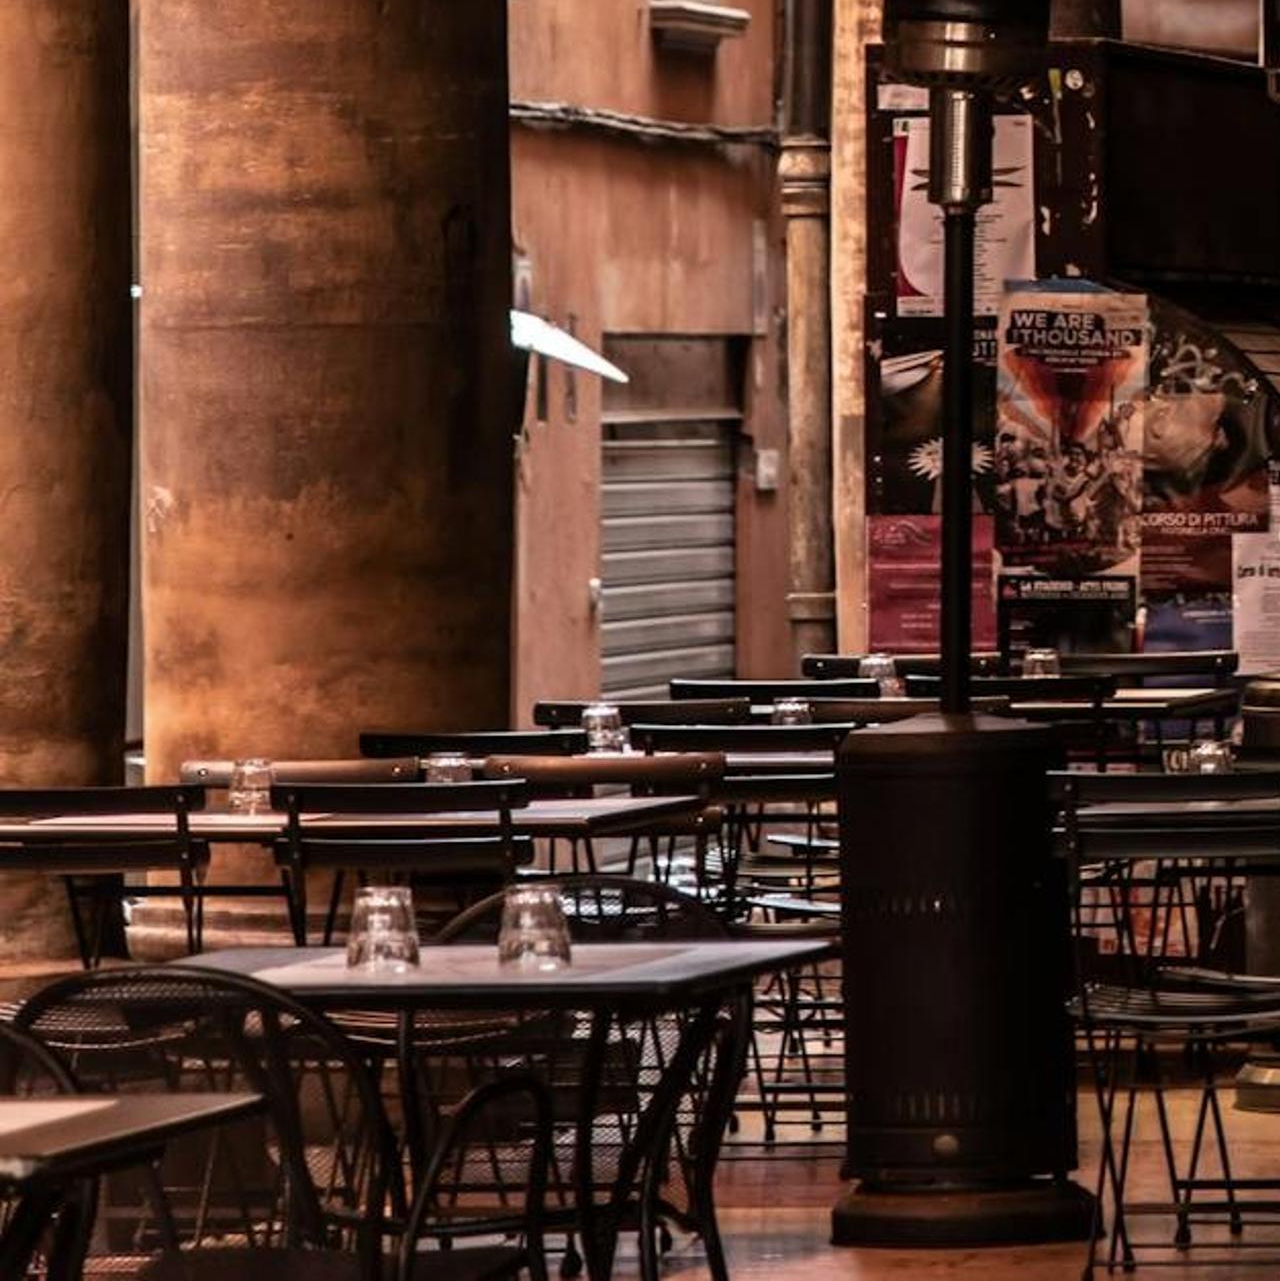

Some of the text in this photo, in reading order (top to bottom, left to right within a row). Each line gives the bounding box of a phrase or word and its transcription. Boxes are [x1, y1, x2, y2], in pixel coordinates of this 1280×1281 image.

[1014, 312, 1096, 331] WE ARE
[1020, 328, 1136, 347] THOUSAND
[1141, 512, 1186, 527] CORSO
